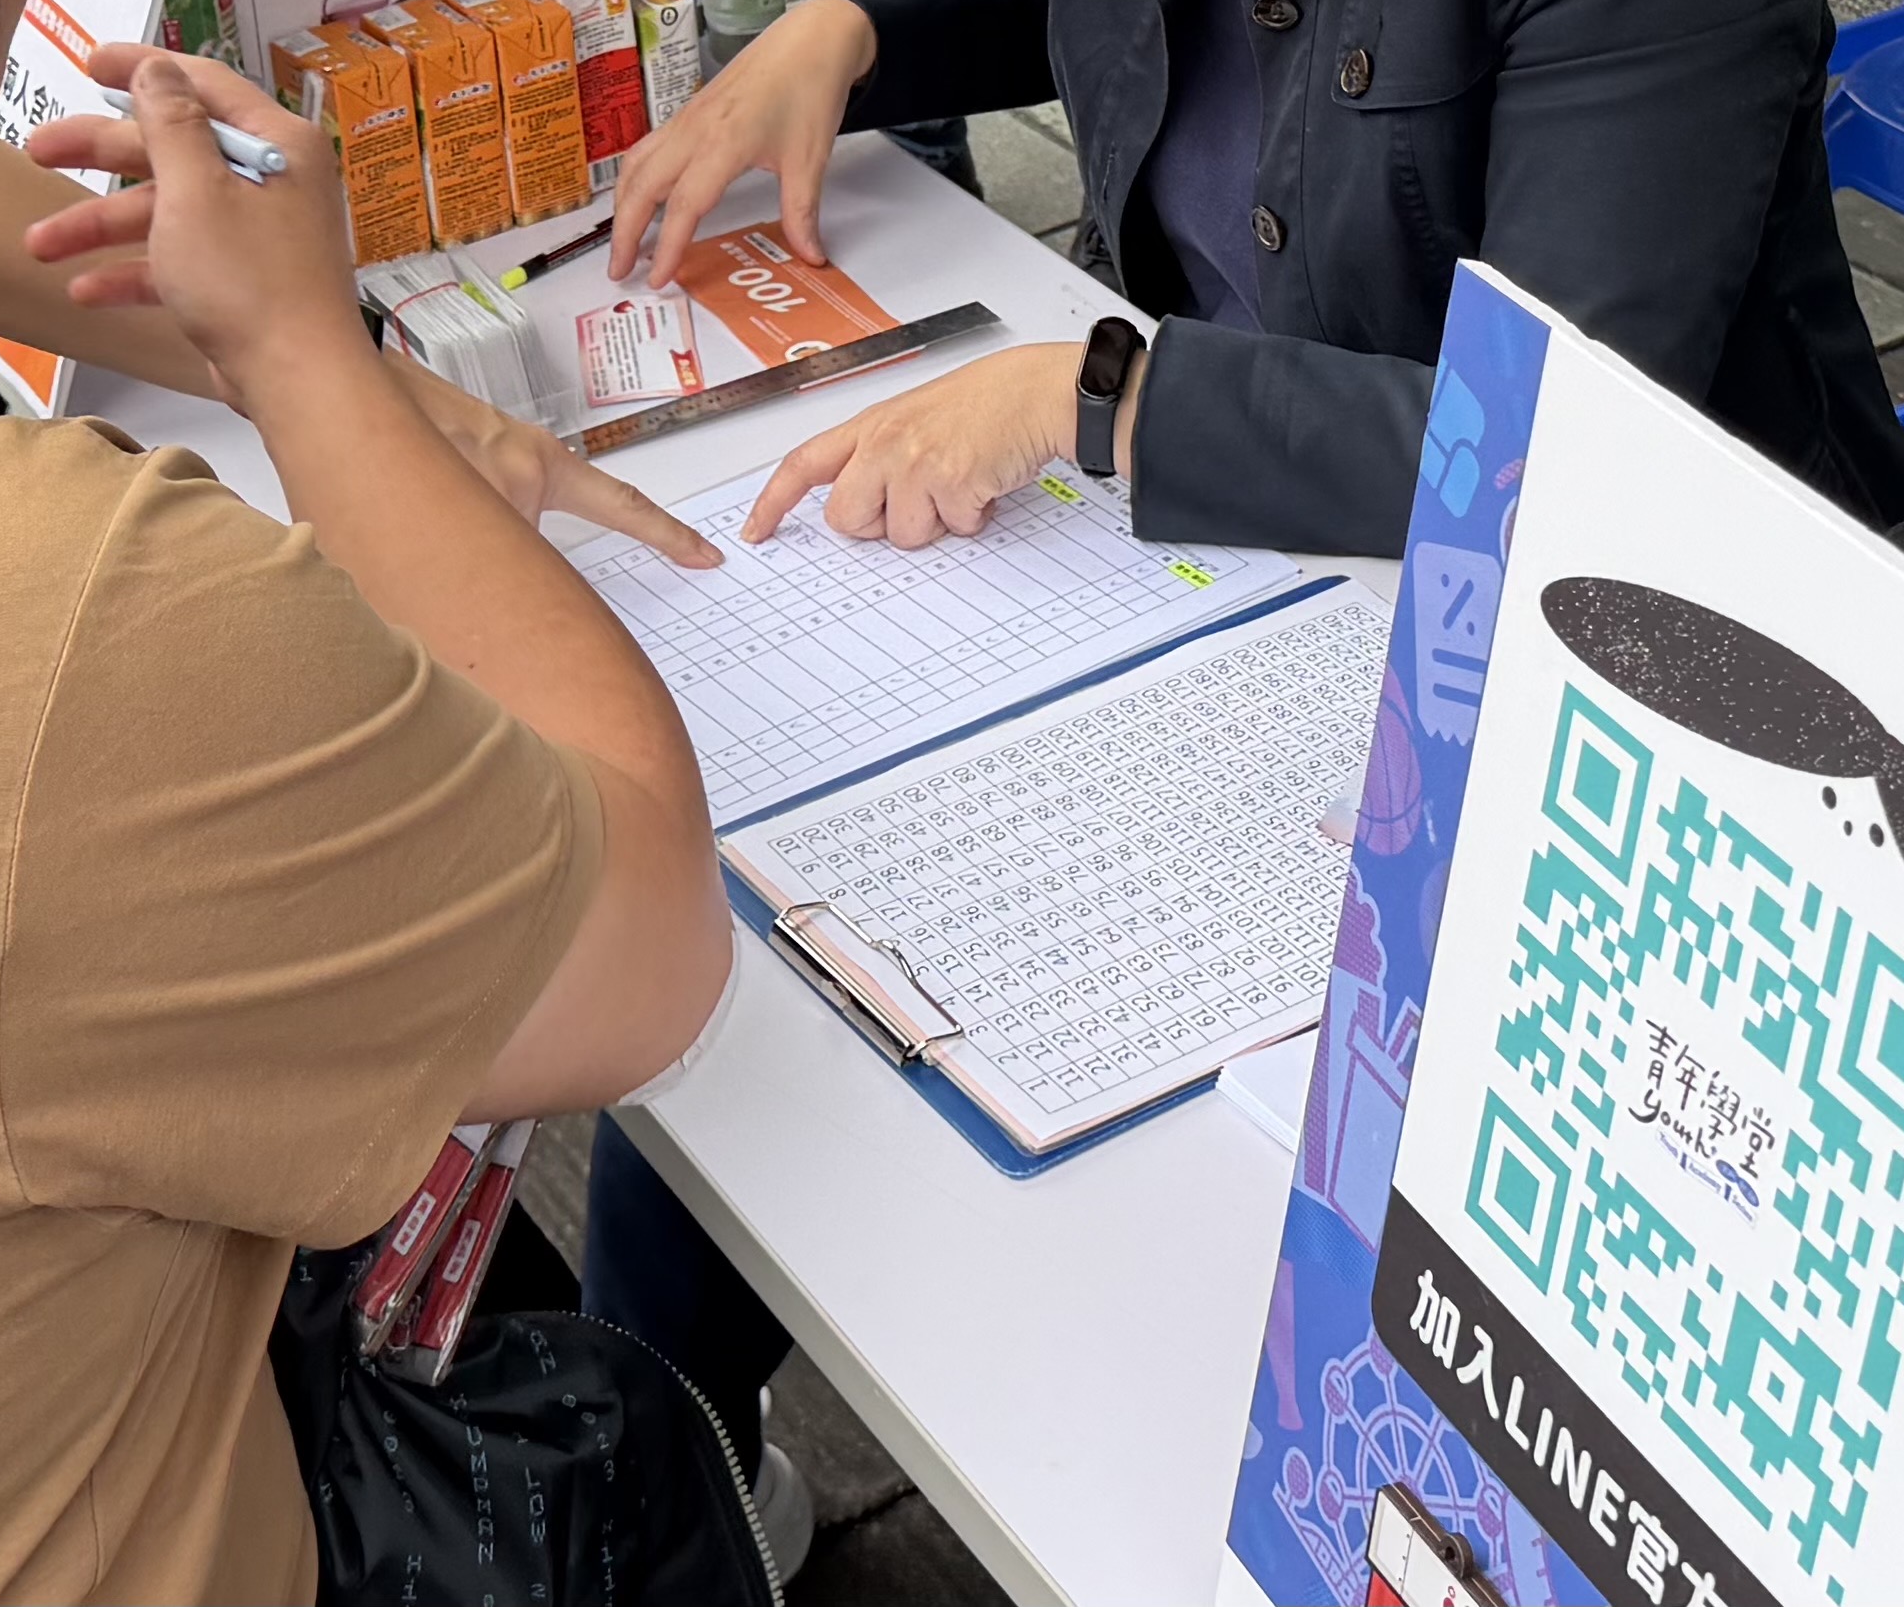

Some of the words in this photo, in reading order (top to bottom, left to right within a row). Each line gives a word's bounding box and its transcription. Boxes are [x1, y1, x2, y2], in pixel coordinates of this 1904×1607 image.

[727, 267, 807, 314] 100
[1277, 631, 1302, 652] 220
[1300, 623, 1325, 643] 230
[1232, 650, 1264, 672] 200
[1305, 653, 1332, 674] 219
[1328, 644, 1350, 663] 229
[1260, 672, 1292, 694] 199
[1335, 675, 1363, 696] 218
[1215, 692, 1248, 713] 179
[1289, 694, 1324, 716] 198
[1095, 707, 1127, 729] 140
[1169, 711, 1203, 733] 159
[1244, 714, 1278, 736] 178
[1319, 717, 1352, 739] 197
[1024, 737, 1056, 760] 110
[1048, 727, 1080, 749] 120
[1122, 730, 1155, 753] 139
[1198, 734, 1231, 756] 158
[1272, 738, 1308, 759] 177
[999, 747, 1033, 770] 100
[1075, 751, 1108, 773] 119
[1150, 754, 1185, 776] 138
[1226, 758, 1261, 779] 157
[952, 767, 976, 782] 80
[1027, 771, 1053, 788] 99
[1051, 761, 1084, 784] 109
[1303, 760, 1338, 783] 176
[902, 787, 927, 802] 60
[1103, 774, 1137, 797] 118
[1178, 780, 1214, 801] 137
[1256, 781, 1292, 804] 156
[978, 791, 1003, 808] 79
[1054, 796, 1081, 812] 98
[1079, 785, 1113, 808] 108
[852, 808, 876, 822] 40
[929, 811, 955, 827] 59
[1131, 799, 1166, 821] 117
[1208, 801, 1244, 825] 136
[1005, 816, 1031, 831] 78
[1081, 821, 1110, 837] 97
[1106, 811, 1142, 832] 107
[801, 827, 828, 845] 20
[878, 832, 905, 846] 39
[955, 836, 981, 851] 58
[1136, 832, 1171, 857] 106
[1160, 823, 1196, 846] 116
[1238, 826, 1274, 850] 135
[775, 839, 803, 858] 10
[1033, 840, 1060, 856] 77
[1111, 845, 1139, 862] 96
[1190, 846, 1226, 871] 115
[827, 852, 854, 870] 19
[905, 856, 932, 875] 38
[983, 861, 1009, 877] 57
[1165, 857, 1201, 883] 105
[1270, 850, 1306, 875] 134
[1061, 865, 1089, 882] 76
[1140, 870, 1169, 888] 95
[853, 877, 881, 896] 18
[932, 883, 960, 899] 37
[1220, 872, 1257, 897] 114
[1091, 891, 1118, 908] 75
[1171, 894, 1199, 913] 94
[1196, 883, 1232, 908] 104
[880, 902, 909, 922] 17
[960, 907, 987, 925] 36
[1040, 912, 1067, 930] 55
[1252, 898, 1289, 923] 113
[1121, 916, 1148, 936] 74
[1202, 921, 1231, 940] 93
[1227, 909, 1263, 935] 103
[907, 928, 936, 949] 16
[988, 931, 1017, 950] 35
[1283, 923, 1321, 949] 112
[1070, 937, 1099, 957] 54
[1151, 943, 1179, 962] 73
[1233, 947, 1262, 966] 92
[1259, 935, 1295, 961] 102
[935, 954, 964, 974] 15
[1018, 959, 1047, 980] 34
[1100, 966, 1129, 986] 53
[1182, 970, 1211, 991] 72
[1266, 973, 1294, 994] 91
[1292, 962, 1327, 989] 101
[964, 983, 993, 1004] 14
[1048, 989, 1077, 1009] 33
[1131, 992, 1159, 1012] 52
[1215, 996, 1243, 1018] 71
[995, 1013, 1023, 1033] 13
[1079, 1015, 1106, 1035] 32
[1163, 1020, 1191, 1040] 51
[1025, 1039, 1054, 1060] 12
[1110, 1043, 1138, 1064] 31
[1056, 1067, 1084, 1087] 11
[1645, 1018, 1776, 1180] 青年學堂
